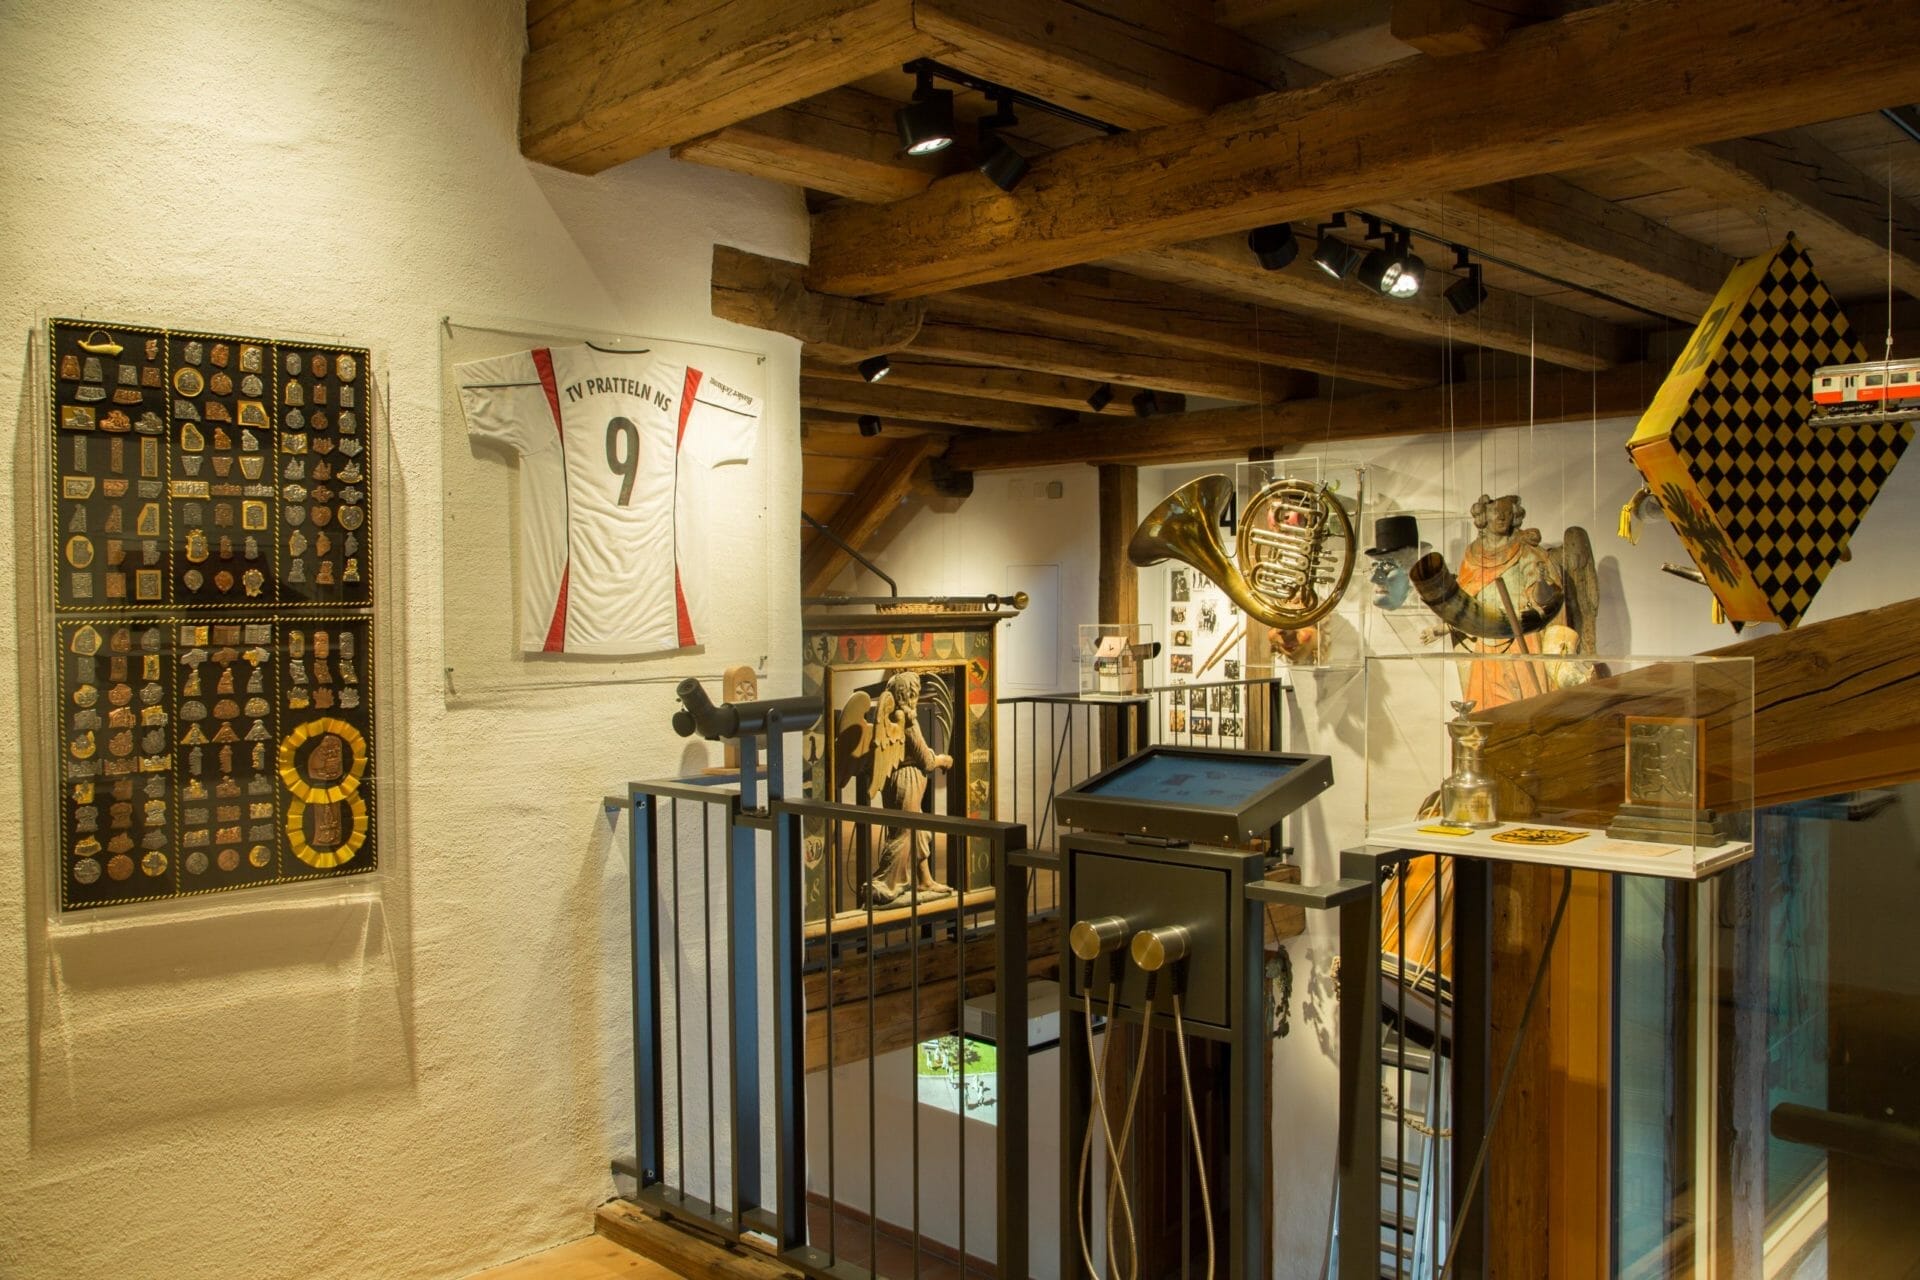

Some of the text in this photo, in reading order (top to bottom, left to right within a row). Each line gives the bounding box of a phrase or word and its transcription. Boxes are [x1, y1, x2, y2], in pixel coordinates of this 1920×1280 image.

[565, 377, 671, 412] TV PRATTELN NS
[605, 416, 640, 506] 9
